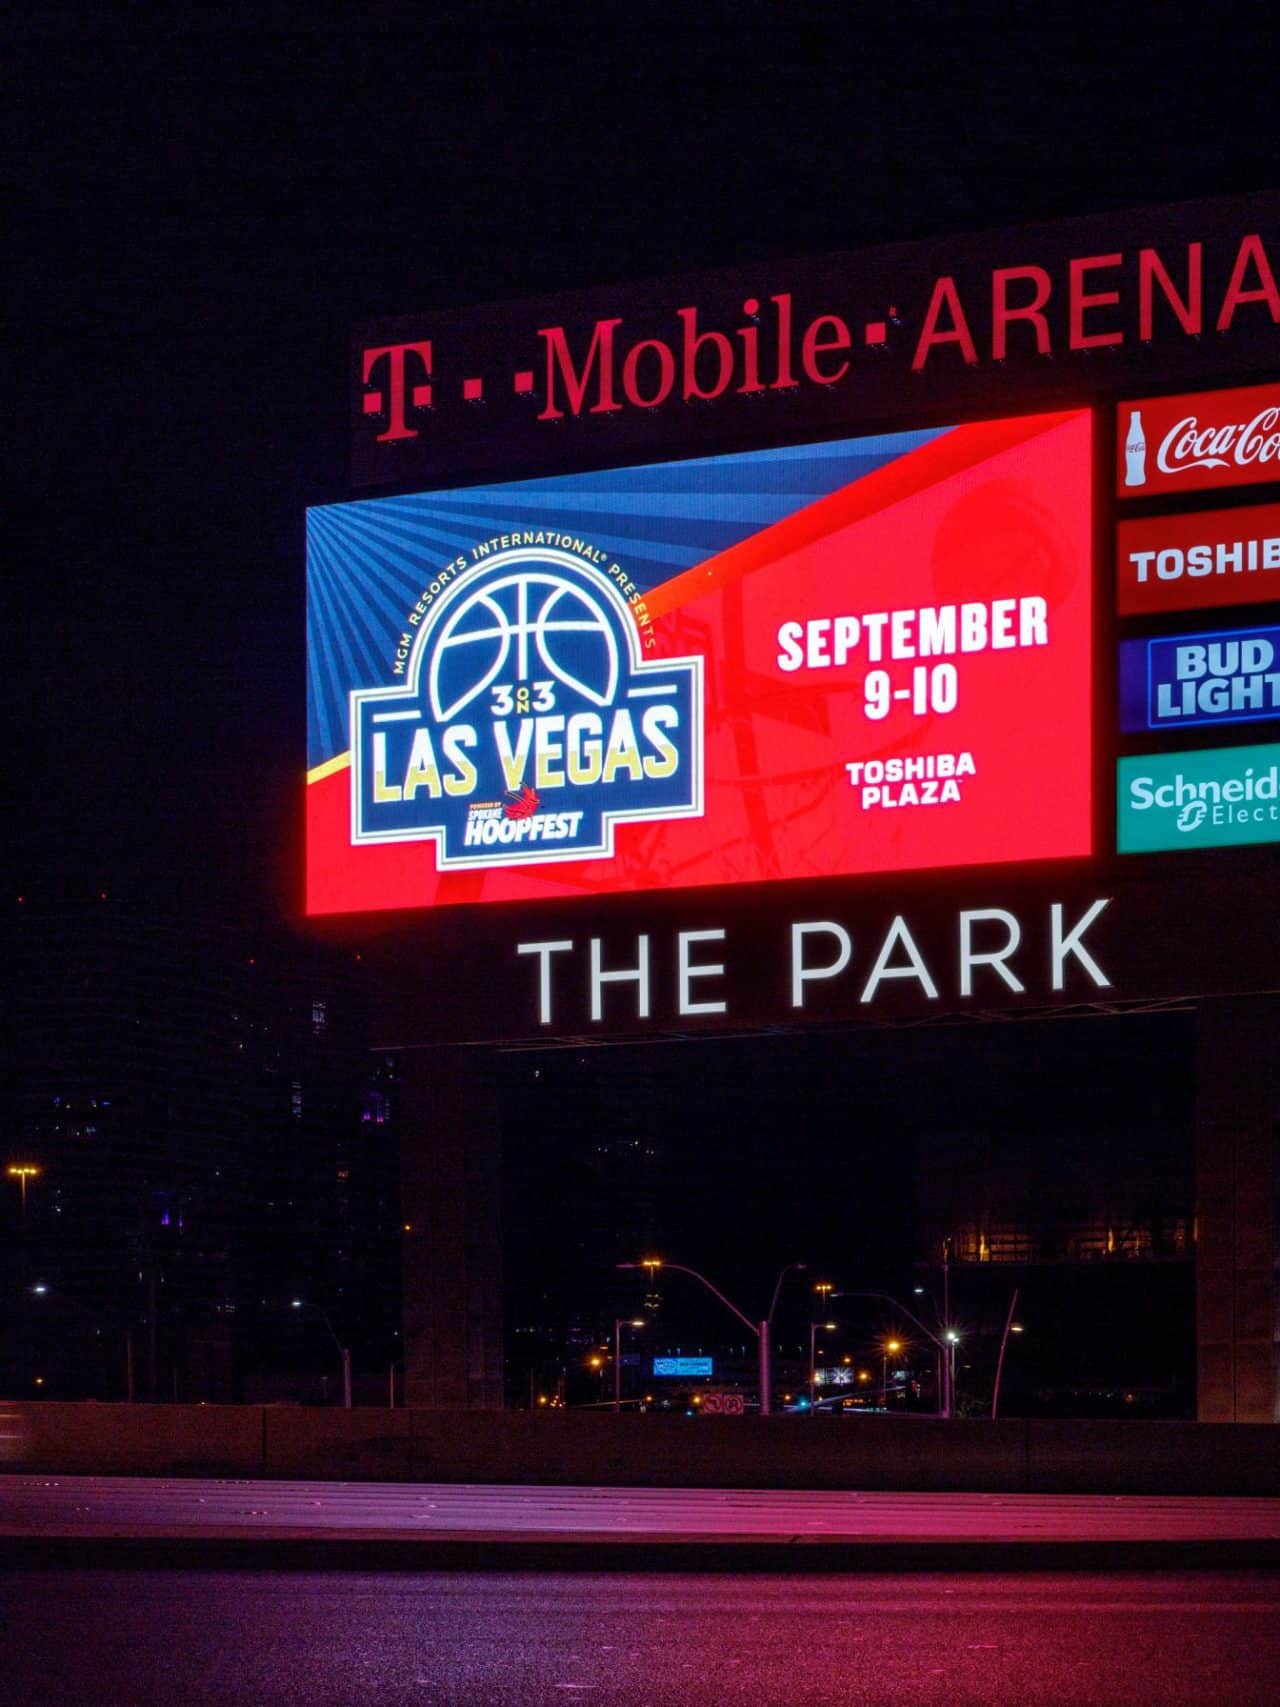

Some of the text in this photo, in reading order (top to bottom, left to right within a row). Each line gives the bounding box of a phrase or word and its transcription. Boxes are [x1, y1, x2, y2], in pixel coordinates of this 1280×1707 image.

[393, 631, 413, 675] MGM
[408, 556, 468, 626] RESORTS
[608, 563, 657, 650] PRESENTS
[777, 596, 1048, 672] SEPTEMBER
[1176, 638, 1275, 680] BUD
[864, 663, 958, 720] 9-10
[373, 705, 679, 803] LAS VEGAS
[845, 752, 976, 785] TOSHIBA
[862, 779, 962, 810] PLAZA
[464, 811, 584, 846] HOOPFEST
[517, 898, 1113, 1025] THE PARK
